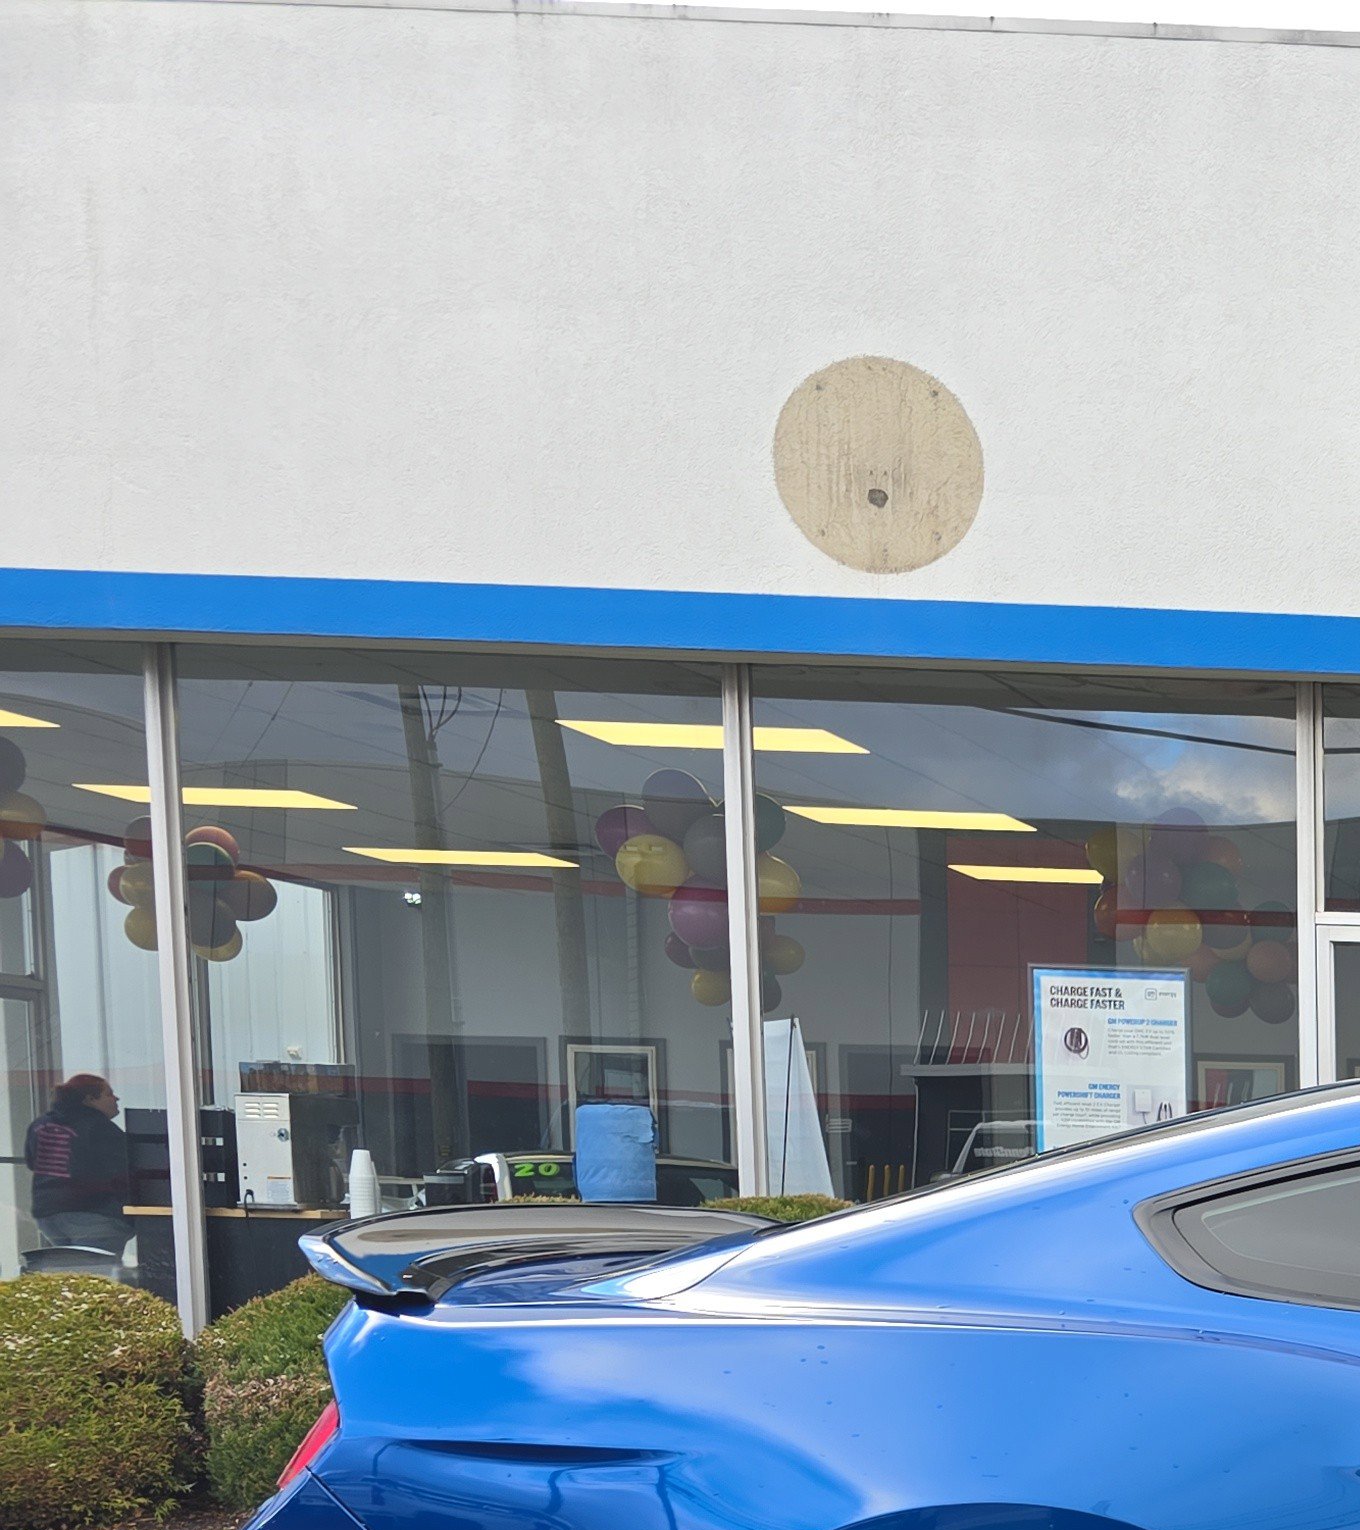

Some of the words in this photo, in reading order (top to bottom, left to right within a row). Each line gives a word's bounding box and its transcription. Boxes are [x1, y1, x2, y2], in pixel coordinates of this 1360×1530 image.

[1050, 986, 1088, 997] CHARGE
[1090, 987, 1113, 998] FAST
[1115, 988, 1122, 998] &
[1050, 997, 1088, 1008] CHARGE
[1090, 998, 1125, 1010] FASTER
[514, 1162, 559, 1177] 20
